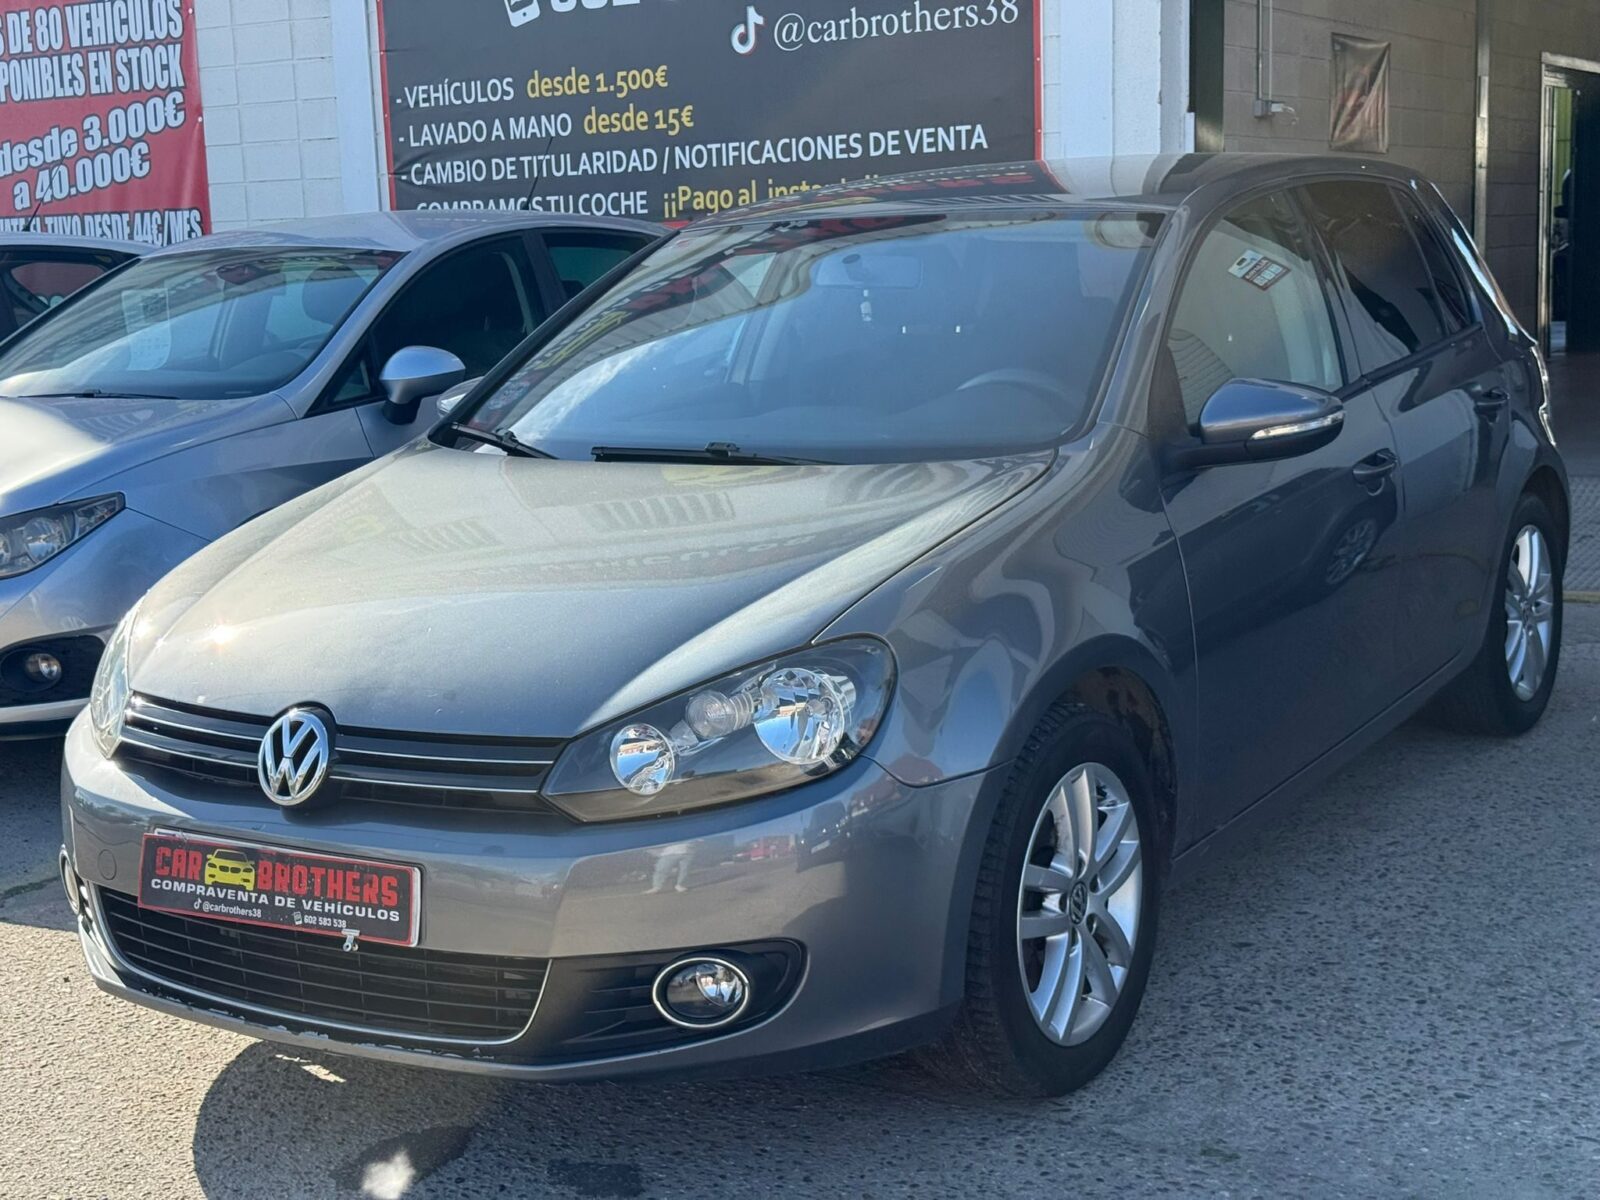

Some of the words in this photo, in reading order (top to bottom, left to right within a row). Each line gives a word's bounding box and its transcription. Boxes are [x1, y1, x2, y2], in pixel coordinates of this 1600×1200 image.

[6, 11, 33, 54] DE
[34, 7, 63, 52] 80
[64, 0, 183, 47] VEHÍCULOS
[774, 0, 1019, 51] @carbrothers38
[87, 50, 114, 94] EN
[115, 43, 185, 93] STOCK
[404, 77, 515, 109] VEHÍCULOS
[526, 66, 590, 98] desde
[595, 65, 669, 98] 1.500€
[0, 127, 78, 178] desde
[83, 91, 186, 151] 3.000€
[409, 119, 487, 148] LAVADO
[491, 117, 505, 141] A
[509, 113, 572, 141] MANO
[583, 103, 649, 135] desde
[654, 105, 695, 136] 15€
[13, 181, 31, 211] a
[35, 142, 150, 203] 40.000€
[410, 158, 487, 186] CAMBIO
[491, 156, 517, 181] DE
[519, 148, 658, 179] TITULARIDAD
[674, 133, 863, 170] NOTIFICACIONES
[869, 130, 900, 157] DE
[904, 124, 988, 154] VENTA
[545, 195, 575, 213] TU
[578, 191, 649, 216] COCHE
[738, 179, 757, 205] al
[151, 878, 269, 905] COMPRAVENTA
[274, 895, 296, 909] DE
[302, 899, 400, 922] VEHÍCULOS
[155, 846, 203, 881] CAR
[257, 859, 399, 907] BROTHERS
[202, 901, 262, 918] @carbrothers38
